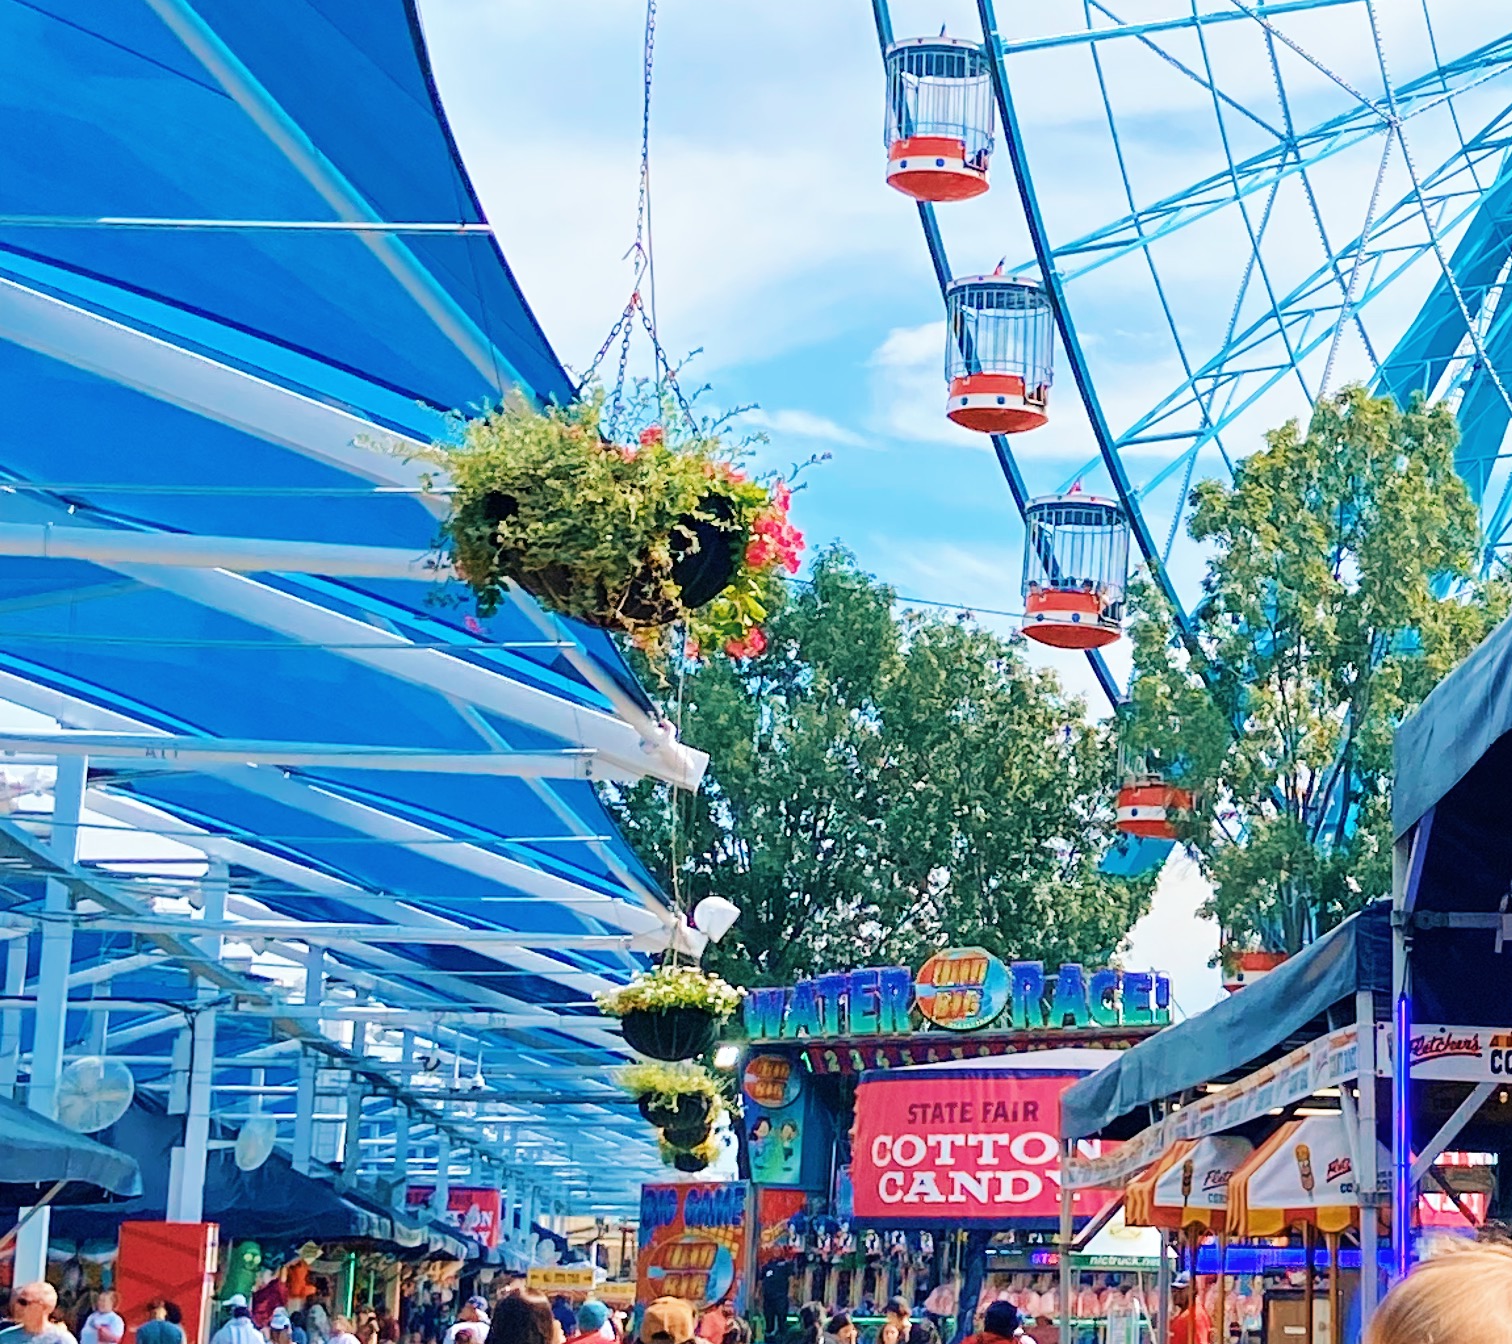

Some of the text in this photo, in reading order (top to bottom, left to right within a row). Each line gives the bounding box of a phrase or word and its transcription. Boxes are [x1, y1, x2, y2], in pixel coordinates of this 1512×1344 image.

[743, 961, 1171, 1039] WATER RACE!
[907, 1100, 1039, 1125] STATE FAIR
